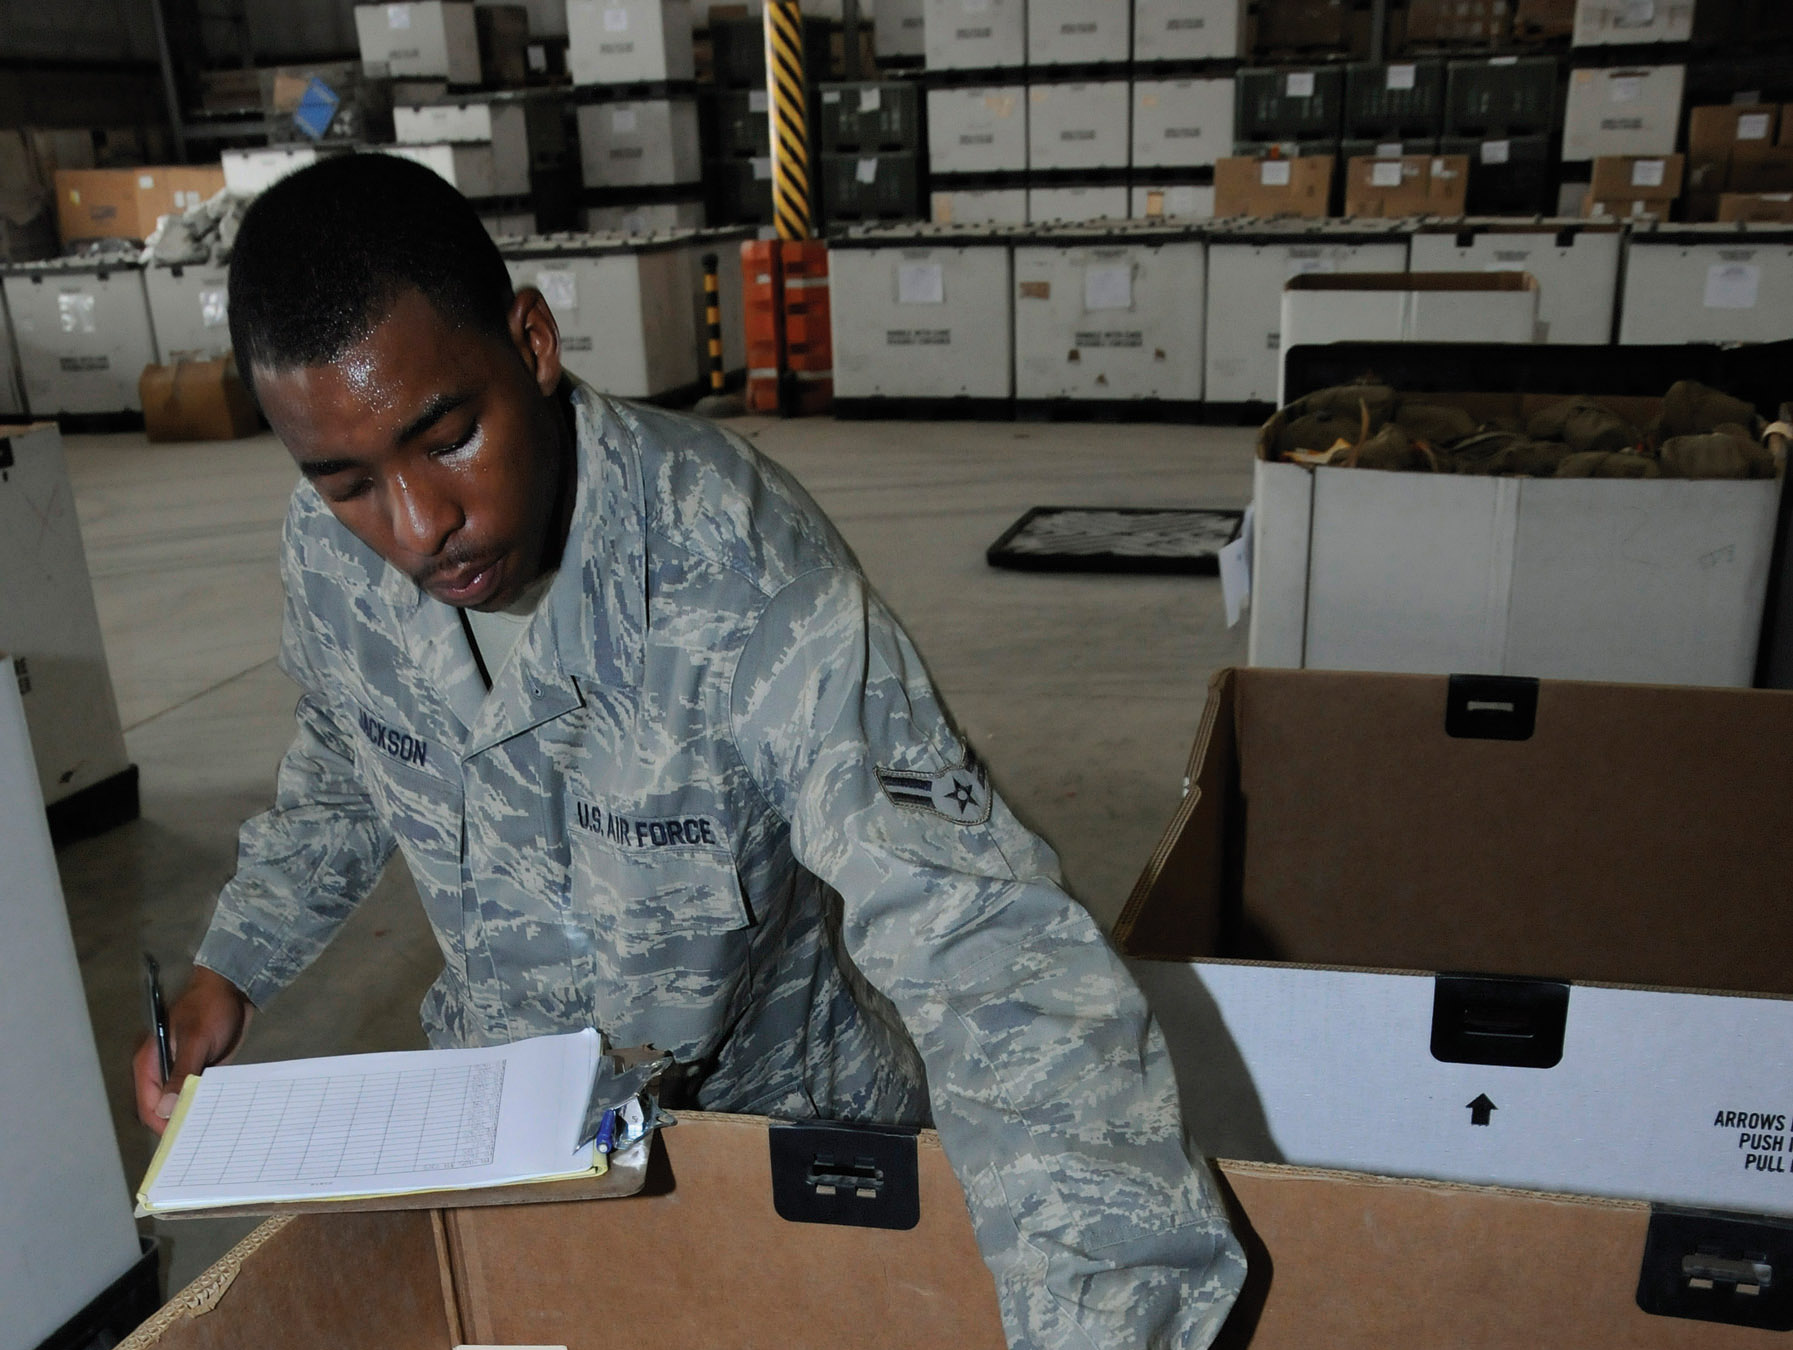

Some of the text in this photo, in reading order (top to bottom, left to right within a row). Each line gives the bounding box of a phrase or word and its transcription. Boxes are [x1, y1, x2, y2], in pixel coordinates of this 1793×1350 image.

[577, 801, 716, 848] U.S. AIR FORCE
[1714, 1110, 1786, 1132] ARROWS
[1738, 1132, 1784, 1152] PUSH
[1744, 1153, 1785, 1173] PULL
